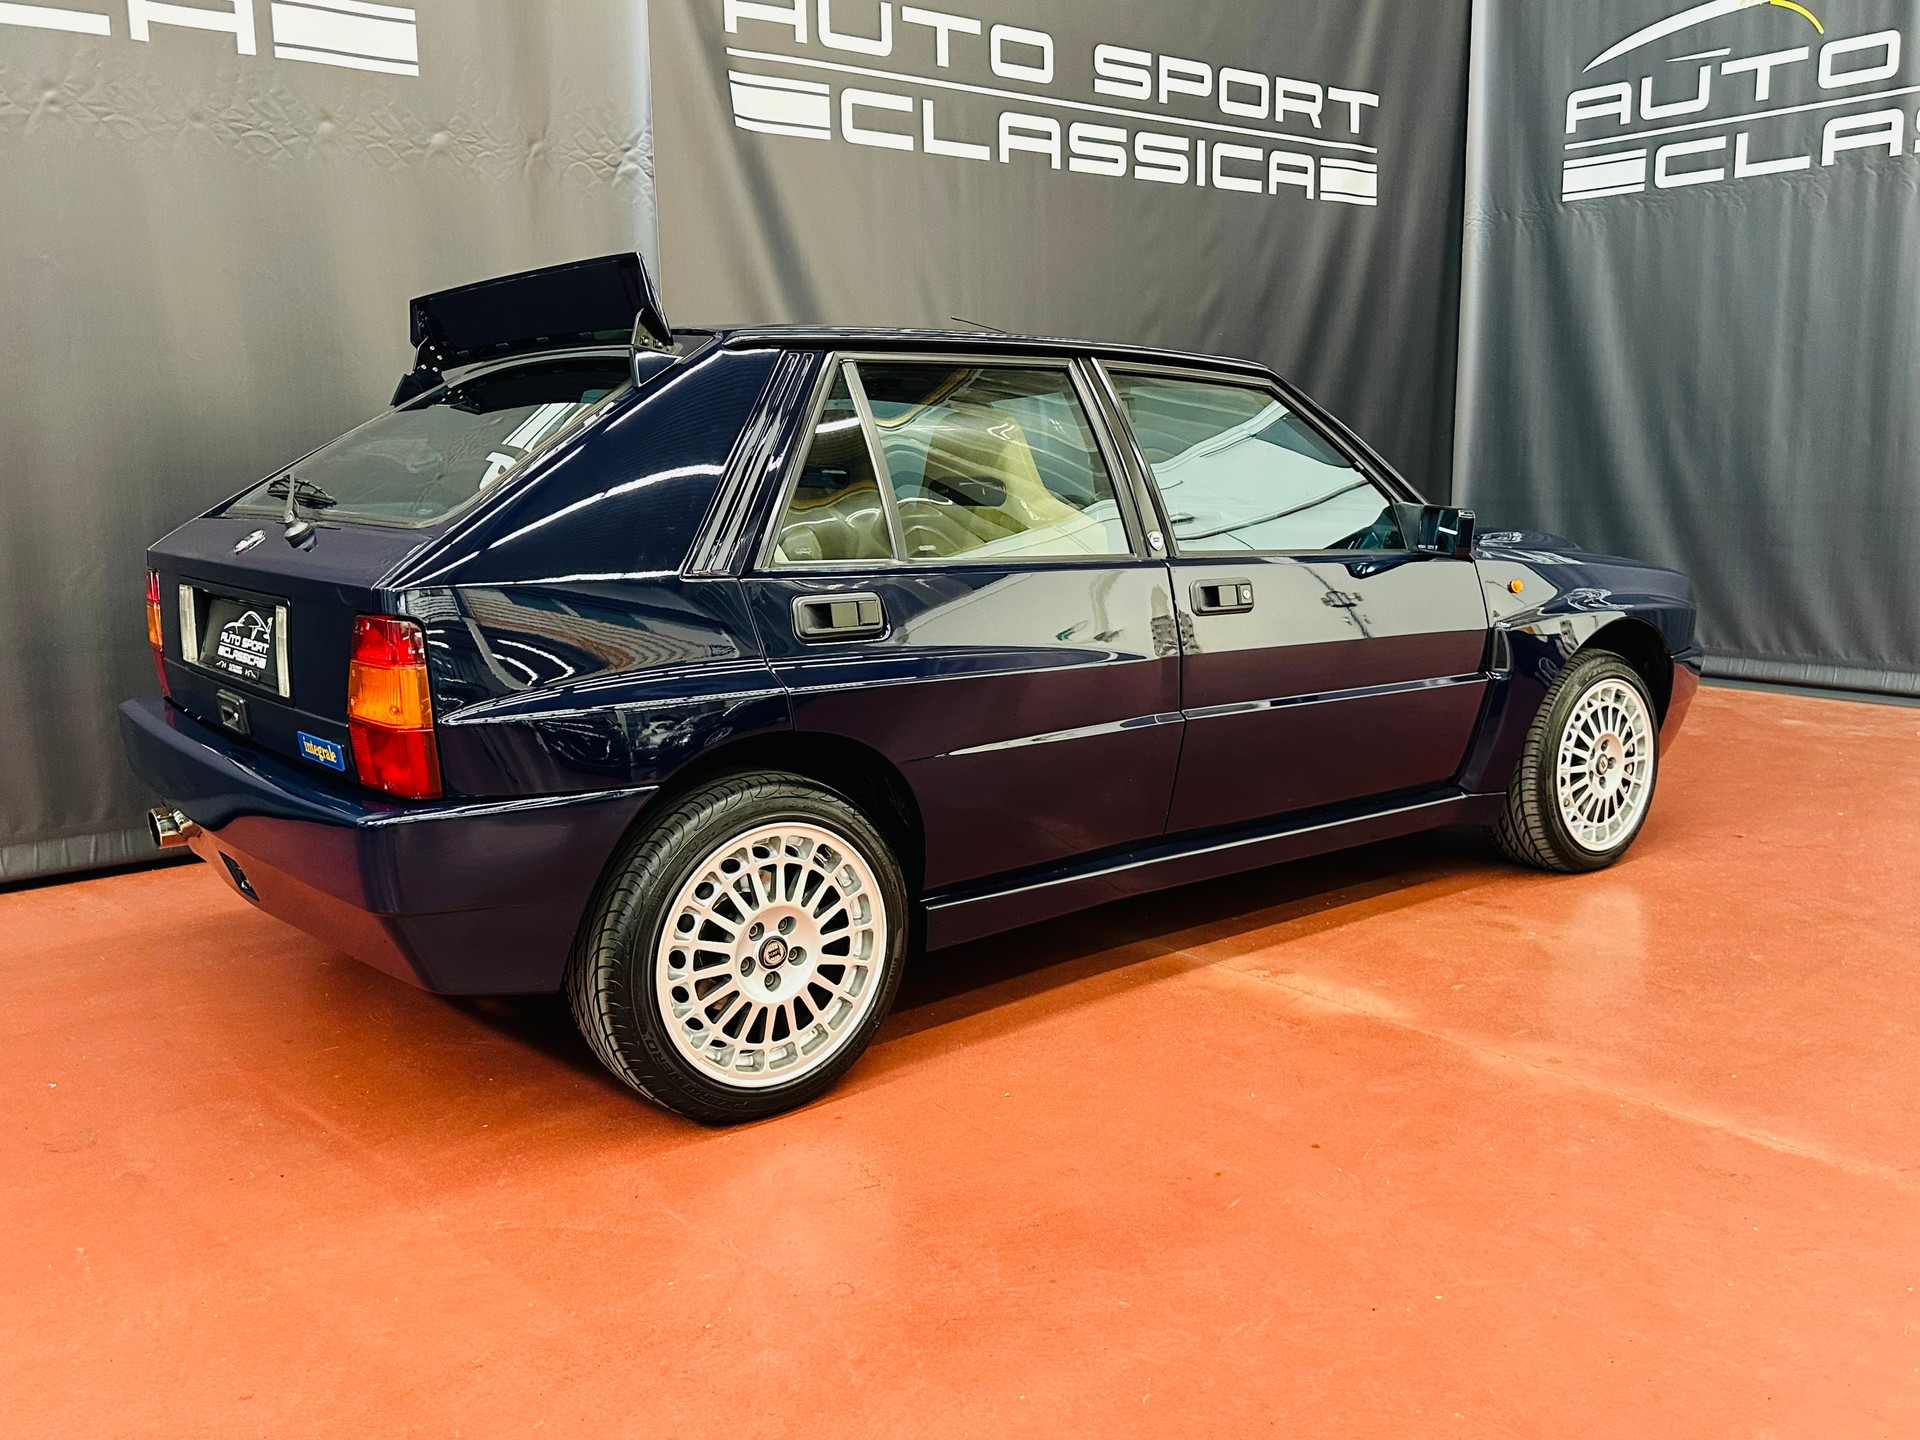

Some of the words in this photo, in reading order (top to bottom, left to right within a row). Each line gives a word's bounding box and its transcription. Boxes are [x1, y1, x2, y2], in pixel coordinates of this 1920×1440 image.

[724, 0, 1054, 84] AUTO
[1093, 43, 1379, 134] SPORT
[1565, 29, 1901, 134] AUTO
[840, 87, 1315, 200] CLASSICA
[1654, 108, 1920, 189] CLA
[220, 631, 241, 646] AUTO
[241, 637, 270, 654] SPORT
[302, 736, 338, 763] integrale
